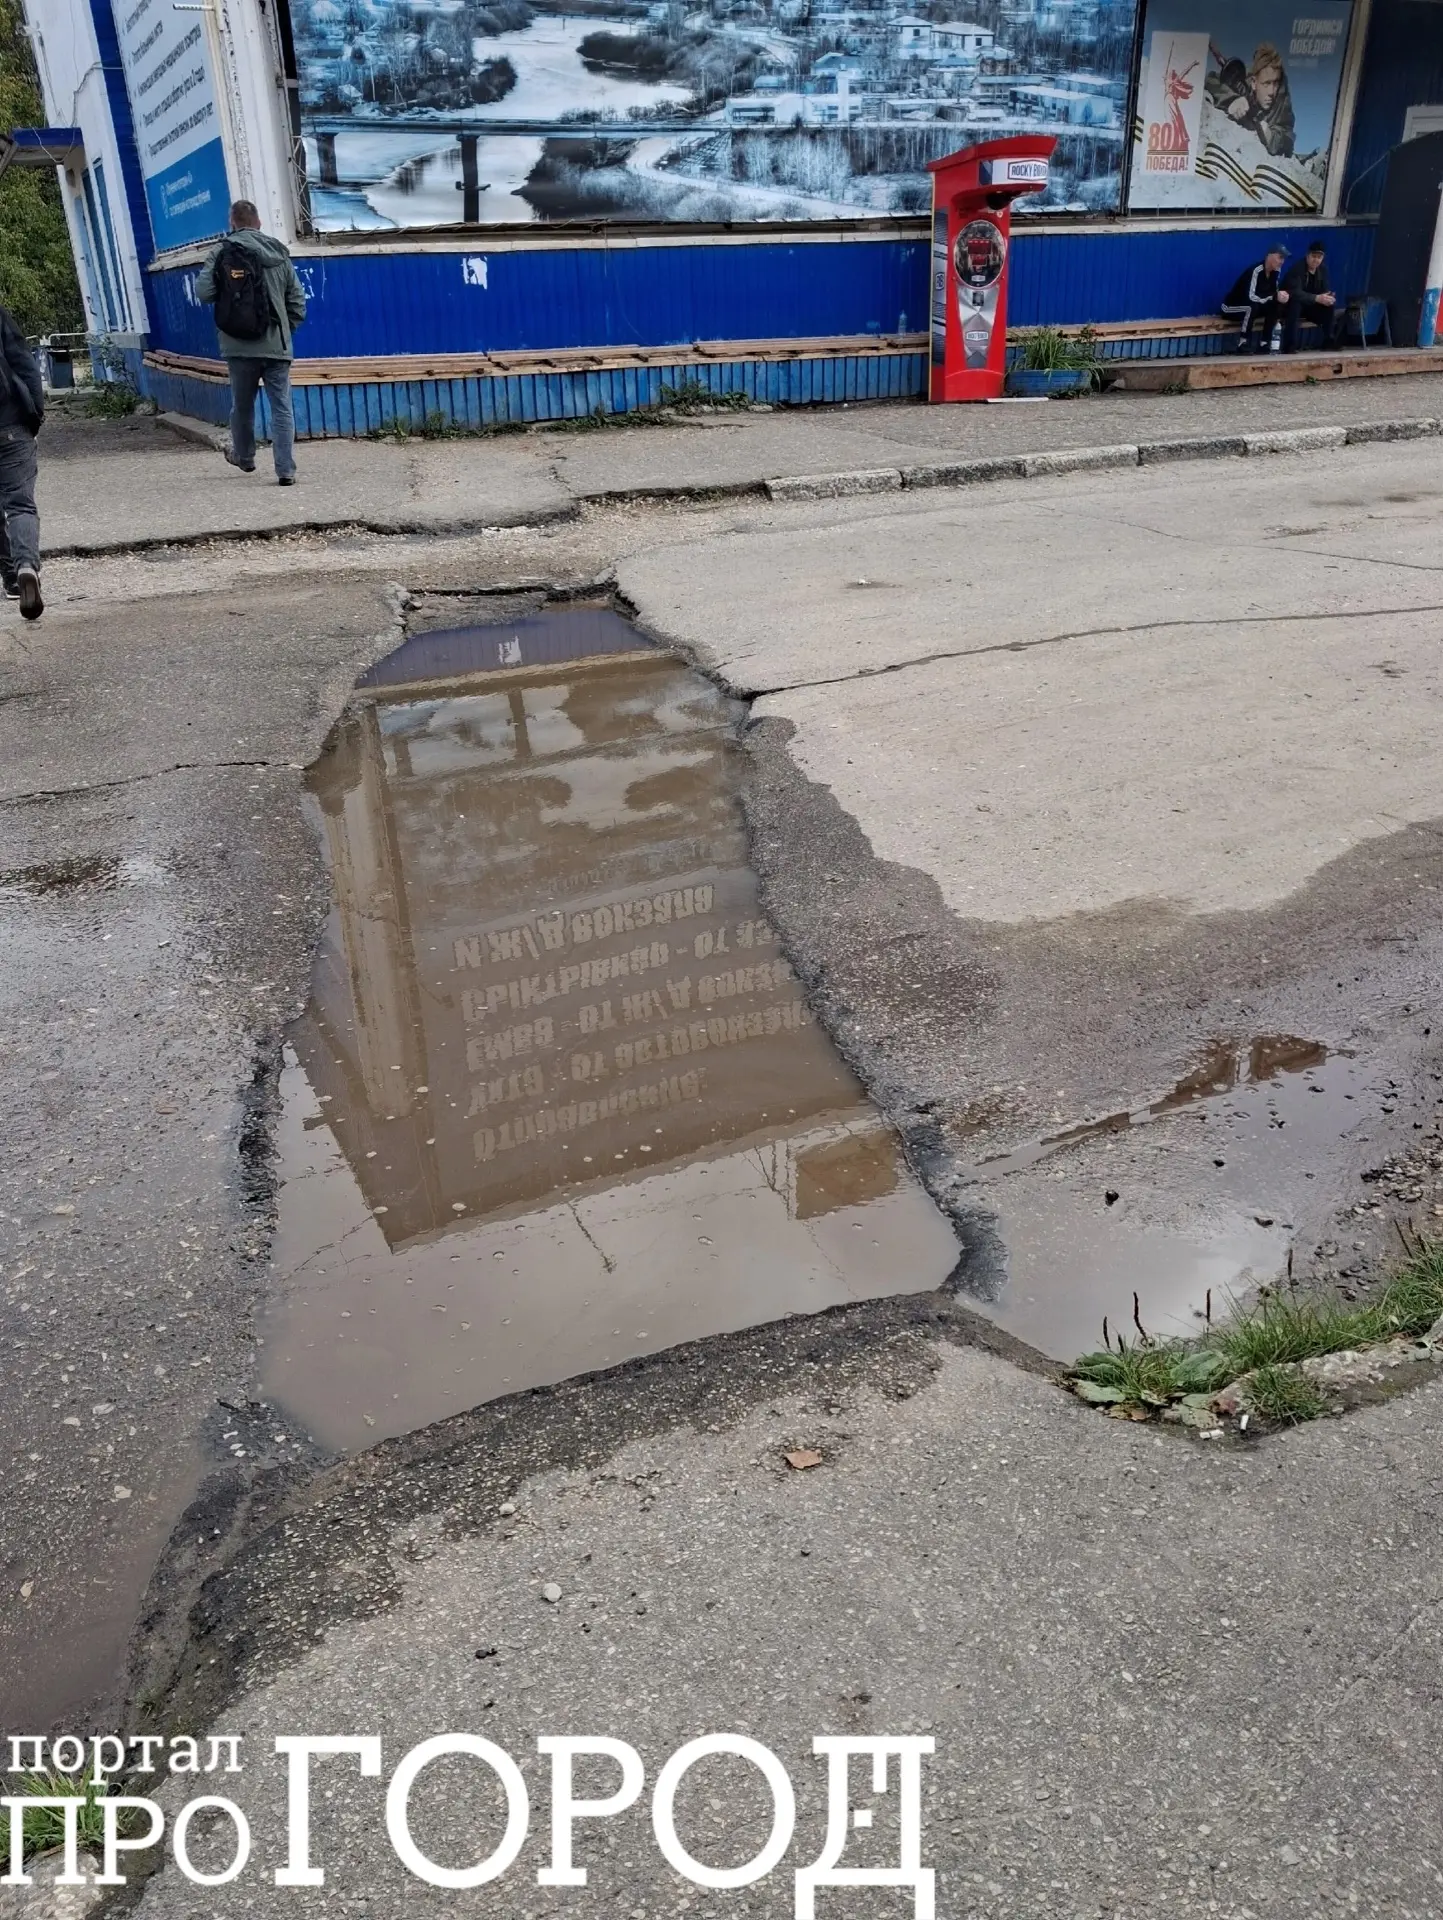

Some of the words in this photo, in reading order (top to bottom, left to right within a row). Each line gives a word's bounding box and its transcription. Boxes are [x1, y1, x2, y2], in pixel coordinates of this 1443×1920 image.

[1291, 18, 1344, 36] ГОРДИМСЯ
[1148, 122, 1173, 150] 80
[1011, 164, 1033, 177] ROCKY
[1146, 156, 1190, 173] ПОБЕДА!
